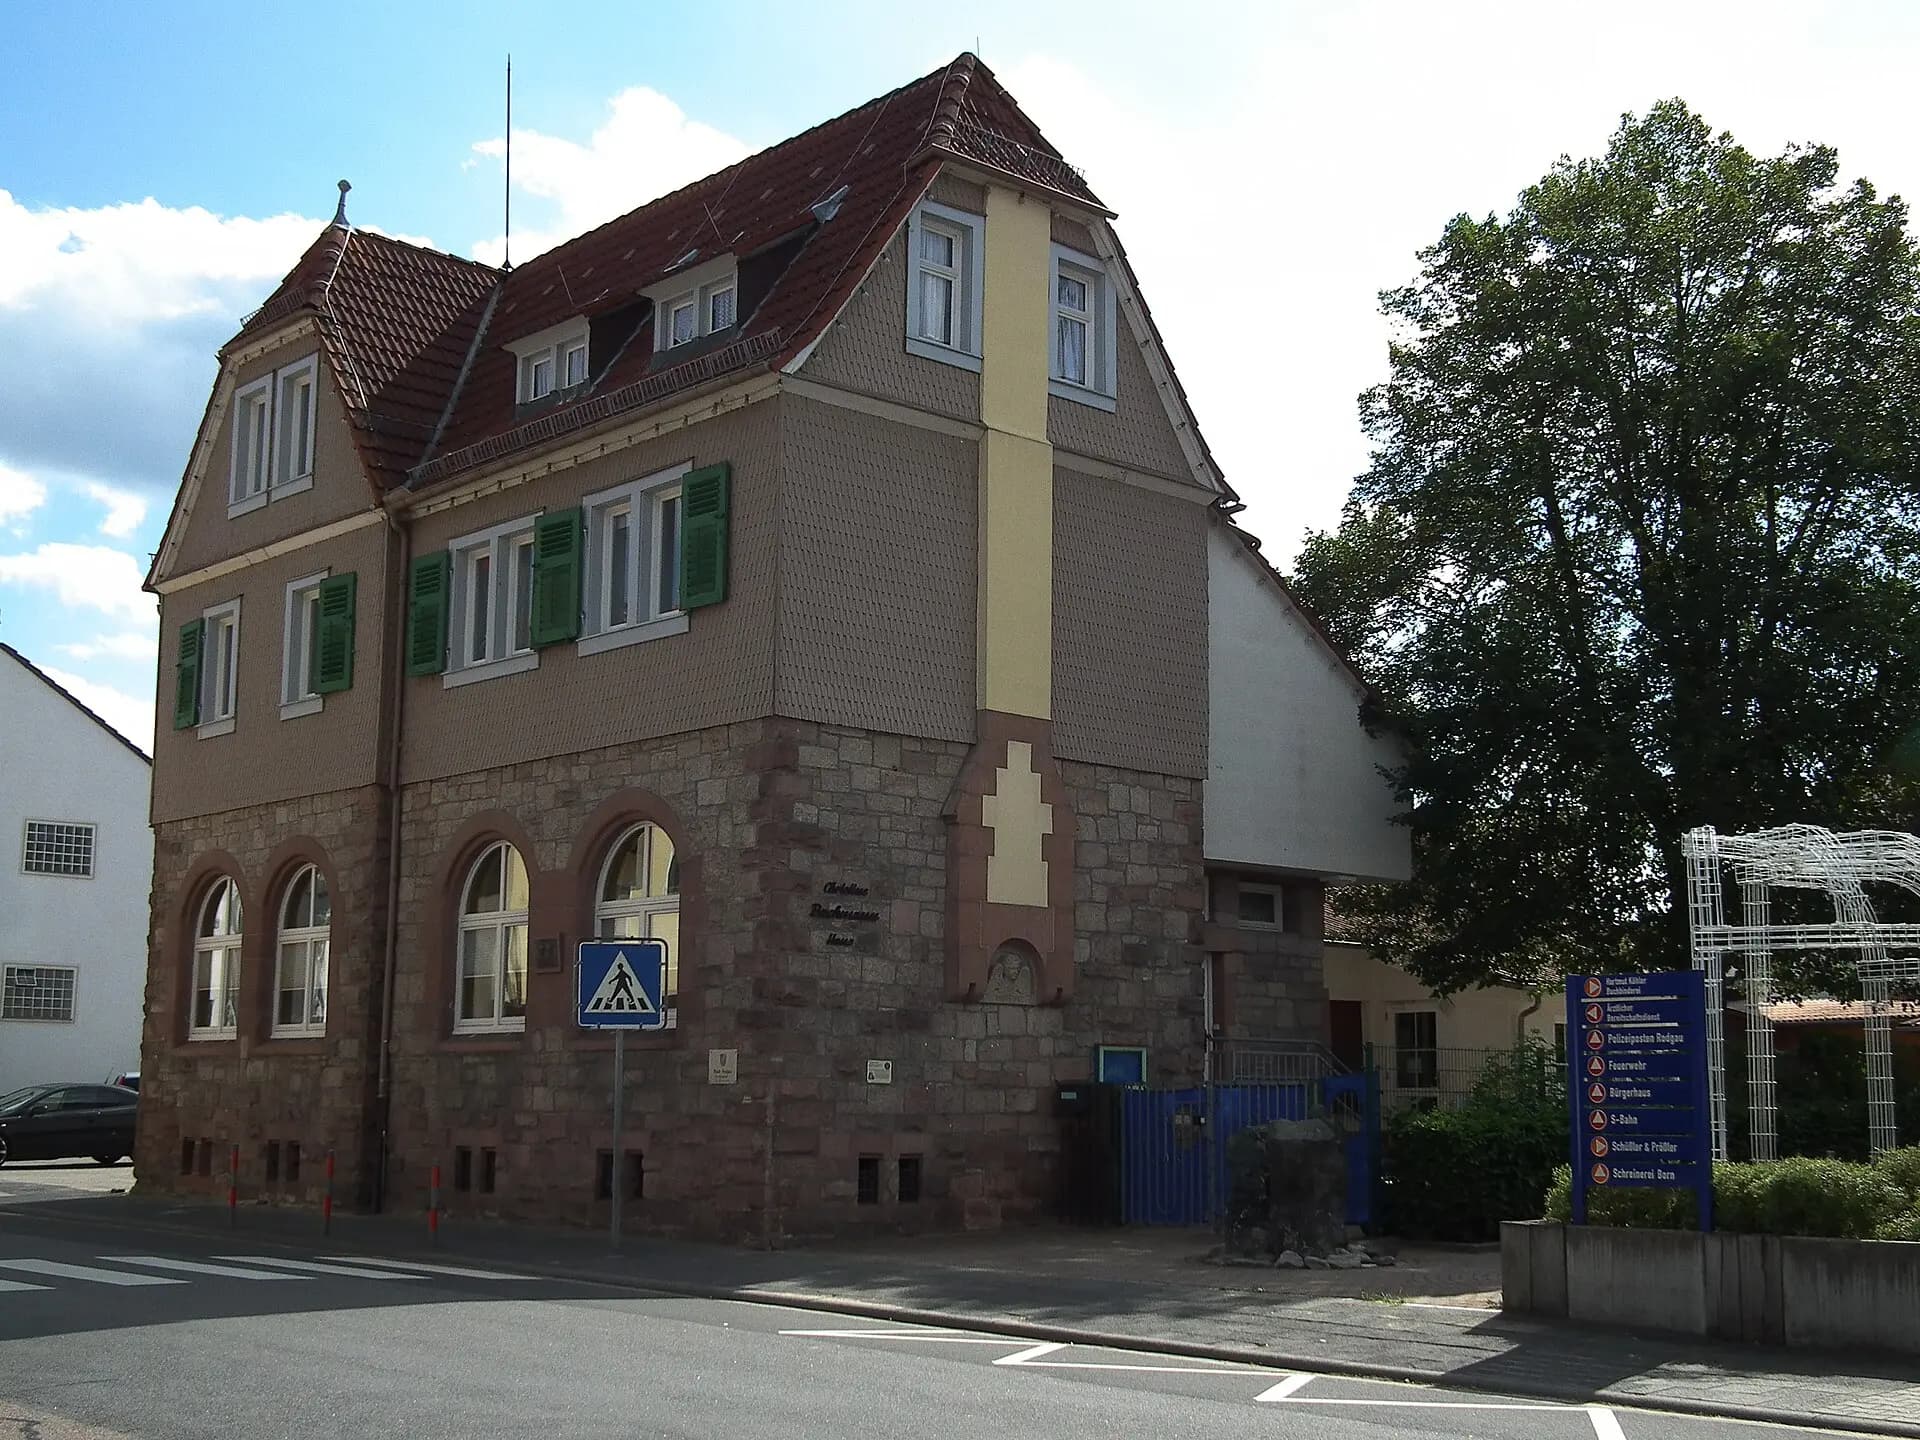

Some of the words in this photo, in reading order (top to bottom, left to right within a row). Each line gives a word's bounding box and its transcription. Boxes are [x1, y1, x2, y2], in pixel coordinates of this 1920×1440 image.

[1606, 1013, 1660, 1022] Bereitschaftsdienst
[1607, 1033, 1655, 1045] Polizeiposten
[1656, 1033, 1684, 1045] Rodgau
[1608, 1060, 1647, 1071] Feuerwehr
[1609, 1087, 1651, 1100] Bürgerhaus
[1610, 1114, 1638, 1125] S-Bahn
[1644, 1142, 1650, 1152] &
[1612, 1167, 1655, 1179] Schreinerei
